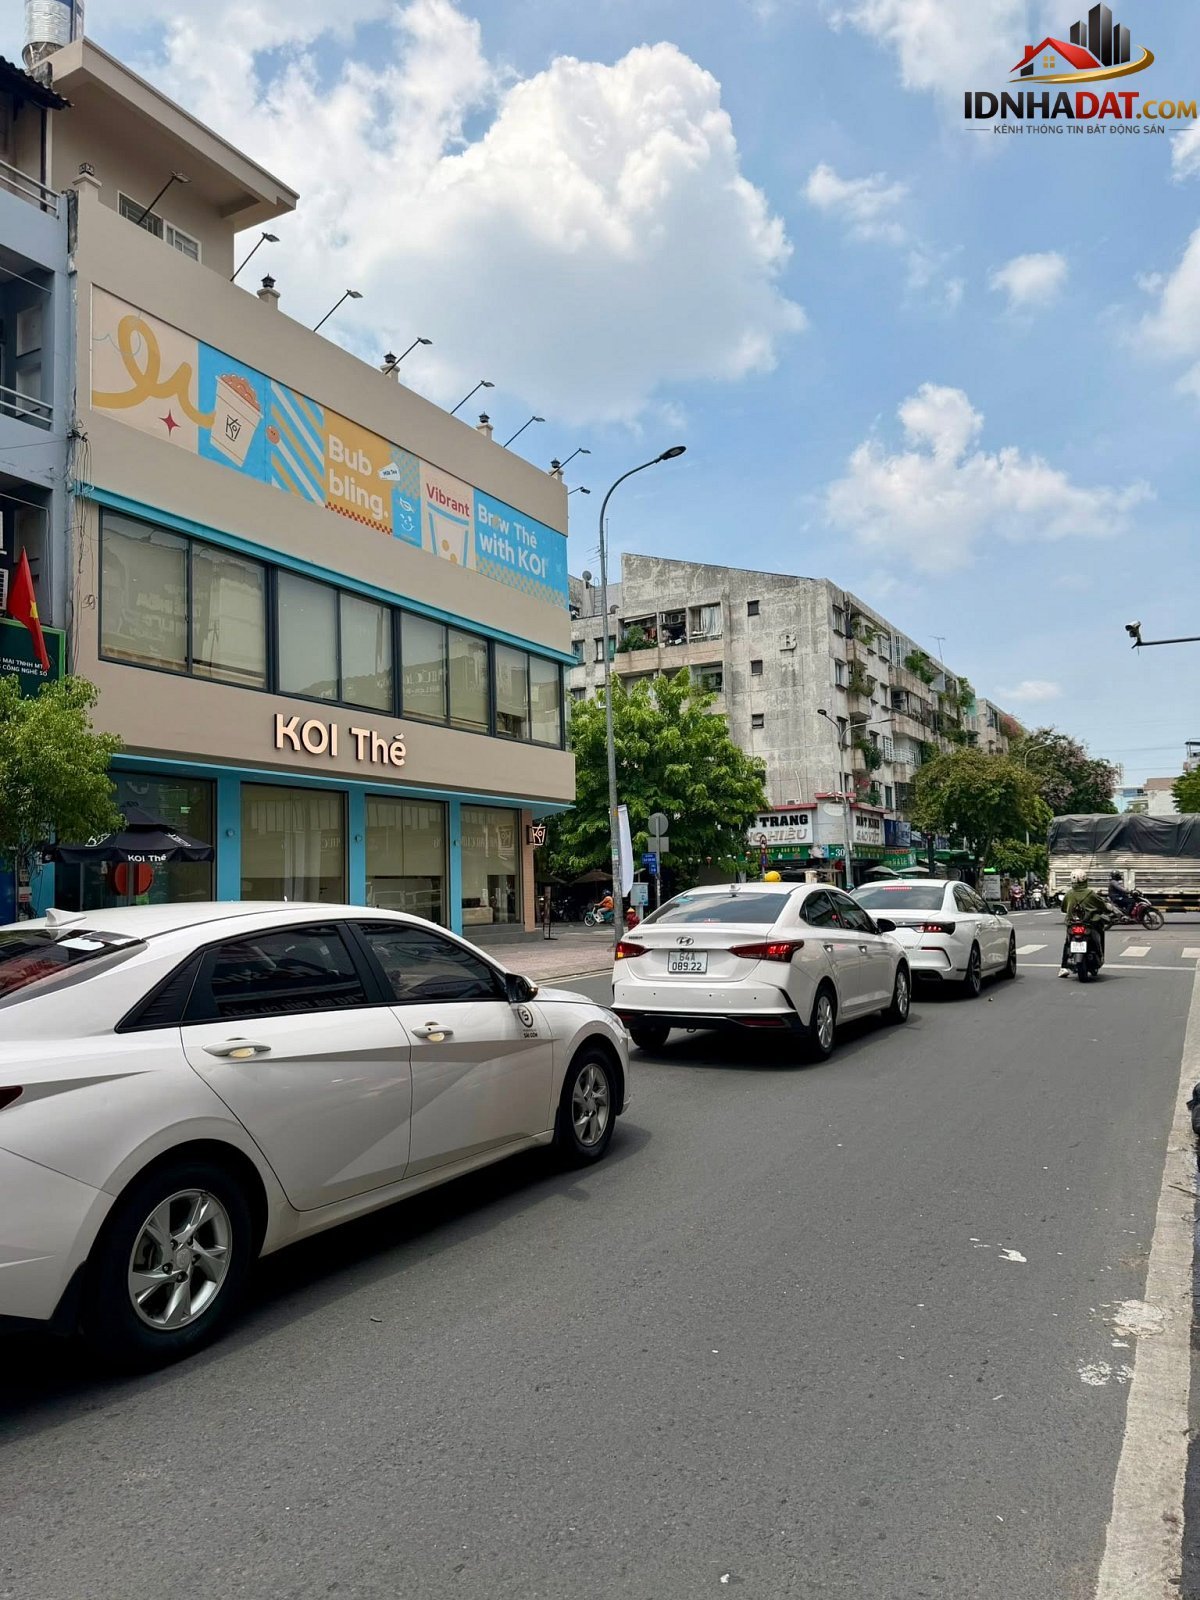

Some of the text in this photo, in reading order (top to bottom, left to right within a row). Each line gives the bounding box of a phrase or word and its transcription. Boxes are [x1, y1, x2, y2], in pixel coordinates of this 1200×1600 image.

[328, 434, 372, 476] Bub
[329, 468, 389, 521] bling.
[426, 483, 470, 517] Vibrant
[513, 522, 538, 549] Thé
[479, 532, 546, 579] with KOI
[274, 713, 407, 766] KOI Thé
[759, 814, 808, 827] TRANG
[127, 853, 167, 862] KOI Thé
[671, 961, 702, 971] 089.22
